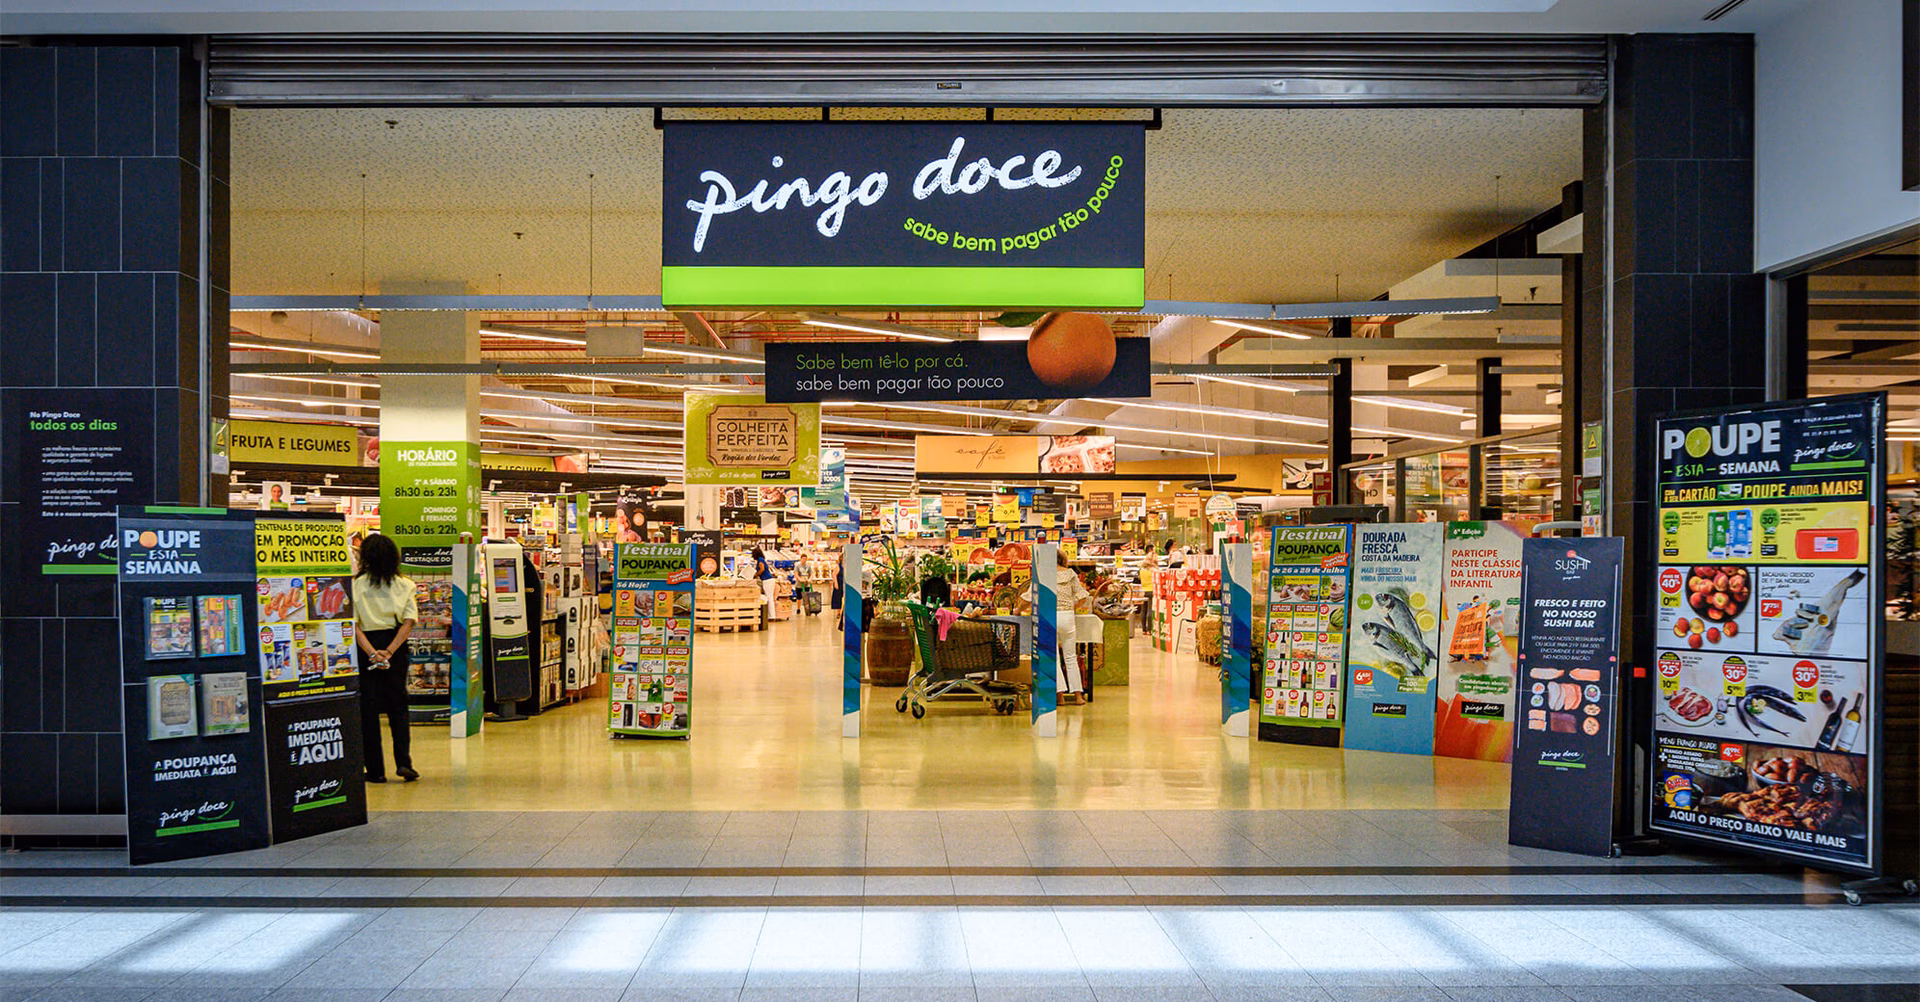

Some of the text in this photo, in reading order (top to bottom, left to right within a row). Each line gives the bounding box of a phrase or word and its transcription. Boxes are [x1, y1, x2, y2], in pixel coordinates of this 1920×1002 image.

[687, 137, 1083, 253] pingo doce
[904, 154, 1124, 255] sabe bem pagar tão pouco
[796, 353, 969, 374] Sabe bem tê-lo por cá.
[796, 374, 1005, 396] sabe bem pagar tão pouco
[42, 411, 62, 420] Pingo
[63, 411, 81, 419] Doce
[30, 419, 118, 431] todos os dias
[716, 422, 789, 433] COLHEITA
[231, 434, 351, 454] FRUTA E LEGUMES
[716, 434, 789, 447] PERFEITA
[1663, 419, 1782, 460] POUPE
[397, 447, 457, 462] HORÁRIO
[1793, 441, 1857, 463] pingo doce
[721, 453, 746, 464] Região
[1675, 460, 1781, 477] ESTA SEMANA
[429, 477, 458, 486] SÁBADO
[394, 487, 458, 498] 8h30 às 23h
[1679, 480, 1865, 502] CARTÃO POUPE AINDA MAIS!
[423, 506, 458, 514] DOMINGO
[255, 523, 345, 534] CENTENAS DE PRODUTOS
[394, 525, 458, 535] 8h30 às 22h
[1461, 528, 1482, 536] Edição
[124, 529, 202, 549] POUPE
[256, 532, 345, 549] EM PROMOÇÃO
[1280, 528, 1347, 542] festival
[1362, 531, 1408, 543] DOURADA
[47, 538, 97, 562] pingo
[257, 545, 348, 563] O MÊS INTEIRO
[622, 543, 690, 557] festival
[1277, 543, 1342, 558] POUPANÇA
[1361, 543, 1399, 554] FRESCA
[1451, 549, 1499, 558] PARTICIPE
[148, 549, 180, 561] ESTA
[404, 556, 440, 564] DESTAQUE
[1361, 554, 1421, 562] COSTA DA MADEIRA
[125, 560, 203, 575] SEMANA
[621, 558, 687, 574] POUPANÇA
[1451, 557, 1523, 569] NESTE CLÁSSIC
[1554, 559, 1589, 571] SUSHI
[1321, 566, 1346, 574] Julho
[1450, 569, 1523, 579] DA LITERATURA
[616, 581, 651, 590] Só Hoje!
[1450, 579, 1493, 589] INFANTIL
[1534, 598, 1607, 609] FRESCO E FEITO
[1542, 609, 1598, 619] NO NOSSO
[1543, 619, 1596, 629] SUSHI BAR
[1373, 703, 1403, 713] pingo doce
[1463, 703, 1500, 713] pingo doce
[288, 717, 342, 733] A POUPANÇA
[288, 728, 343, 749] IMEDIATA
[298, 743, 346, 766] AQUI
[1541, 749, 1581, 760] pingo doce
[154, 753, 238, 770] A POUPANÇA
[154, 769, 202, 782] IMEDIATA
[211, 765, 238, 776] AQUI
[294, 779, 340, 804] pingo doce
[159, 799, 229, 827] pingo doce
[1669, 809, 1848, 849] AQUI O PREÇO BAIXO VALE MAIS
